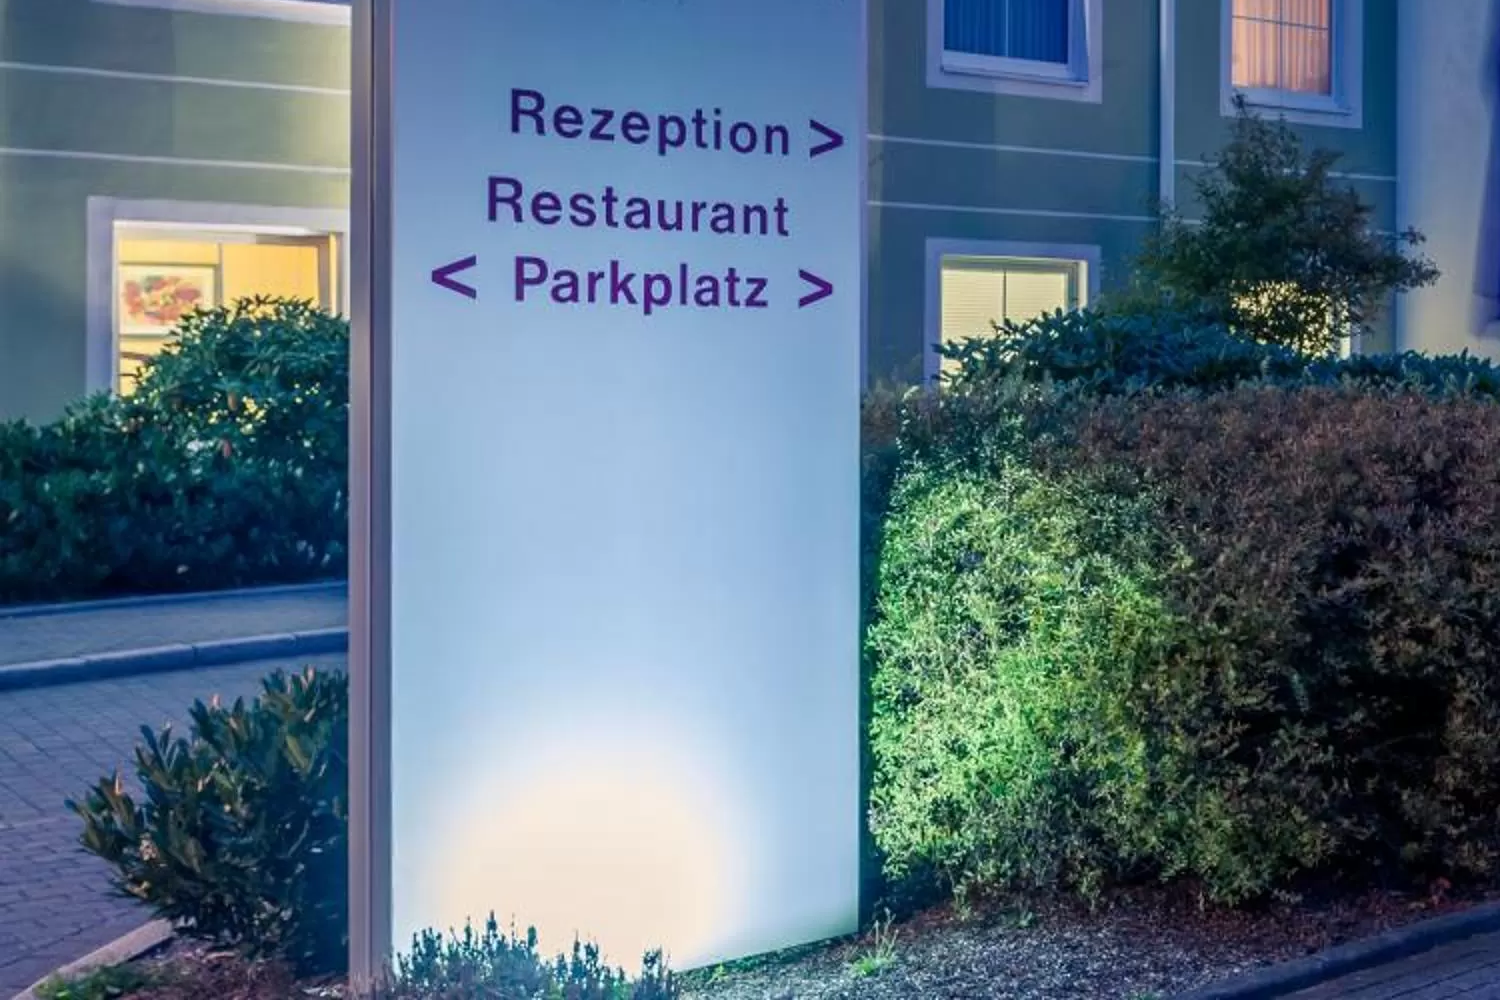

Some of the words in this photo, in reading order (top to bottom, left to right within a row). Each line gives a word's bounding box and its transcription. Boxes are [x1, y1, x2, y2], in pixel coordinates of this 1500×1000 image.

[510, 88, 790, 156] Rezeption
[487, 176, 789, 237] Restaurant
[514, 256, 769, 315] Parkplatz
